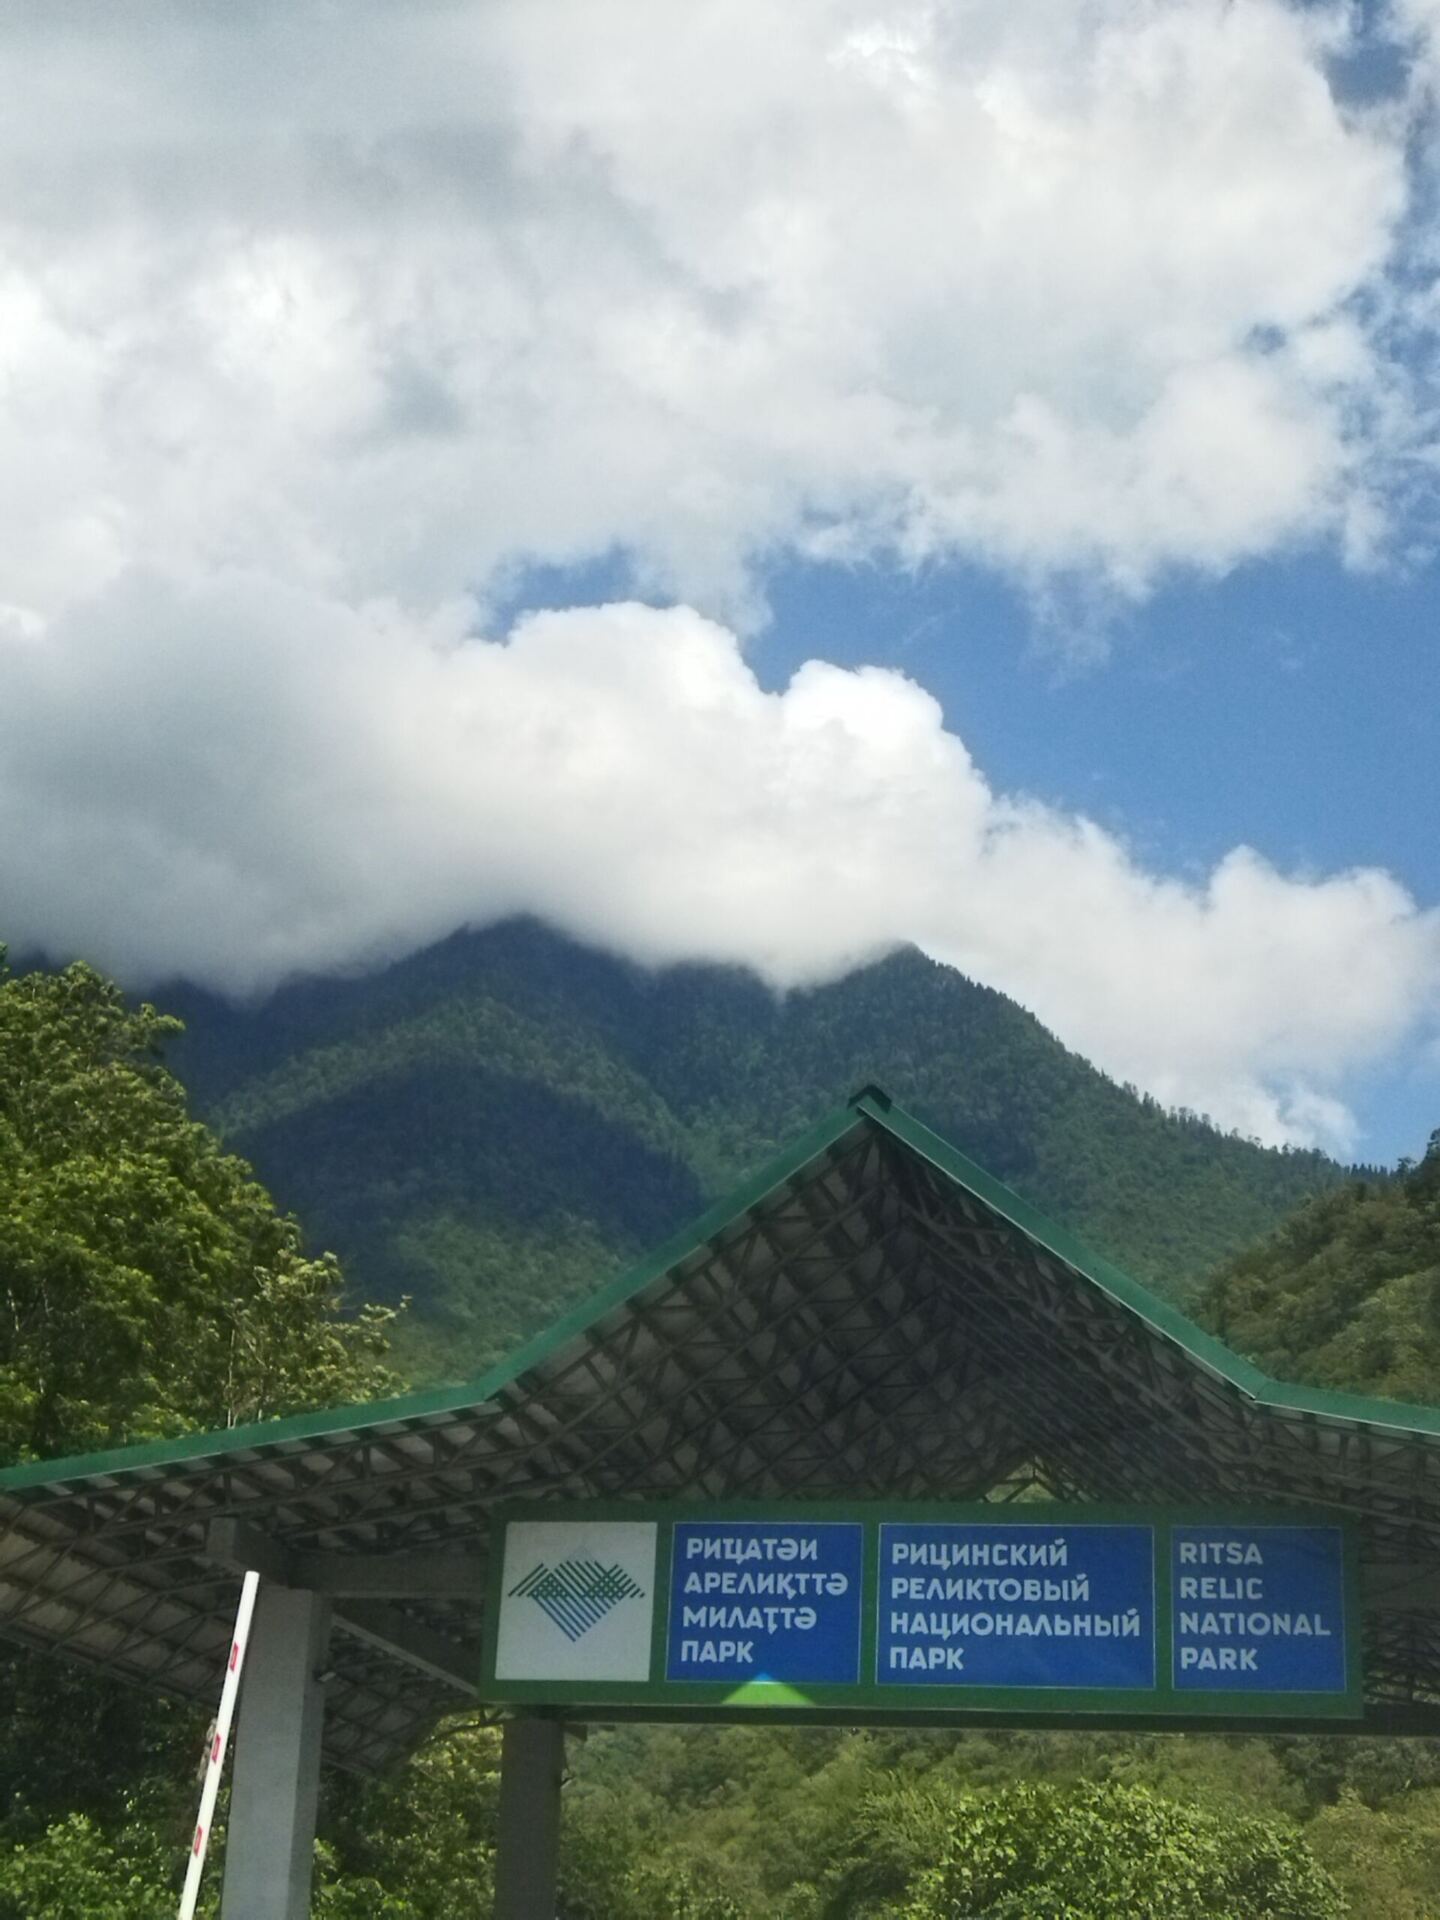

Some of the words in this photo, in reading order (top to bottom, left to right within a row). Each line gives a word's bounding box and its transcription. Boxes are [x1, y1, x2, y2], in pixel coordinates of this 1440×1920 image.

[891, 1538, 1068, 1571] РИЦИНСКИЙ
[1179, 1541, 1264, 1565] RITSA
[891, 1573, 1090, 1602] РЕЛИКТОВЫЙ
[1179, 1576, 1263, 1600] RELIC
[890, 1608, 1140, 1641] НАЦИОНАЛЬНЫЙ
[1179, 1611, 1331, 1636] NATIONAL
[680, 1640, 754, 1664] ПАРК
[889, 1646, 964, 1670] ПАРК
[1180, 1646, 1258, 1671] PARK
